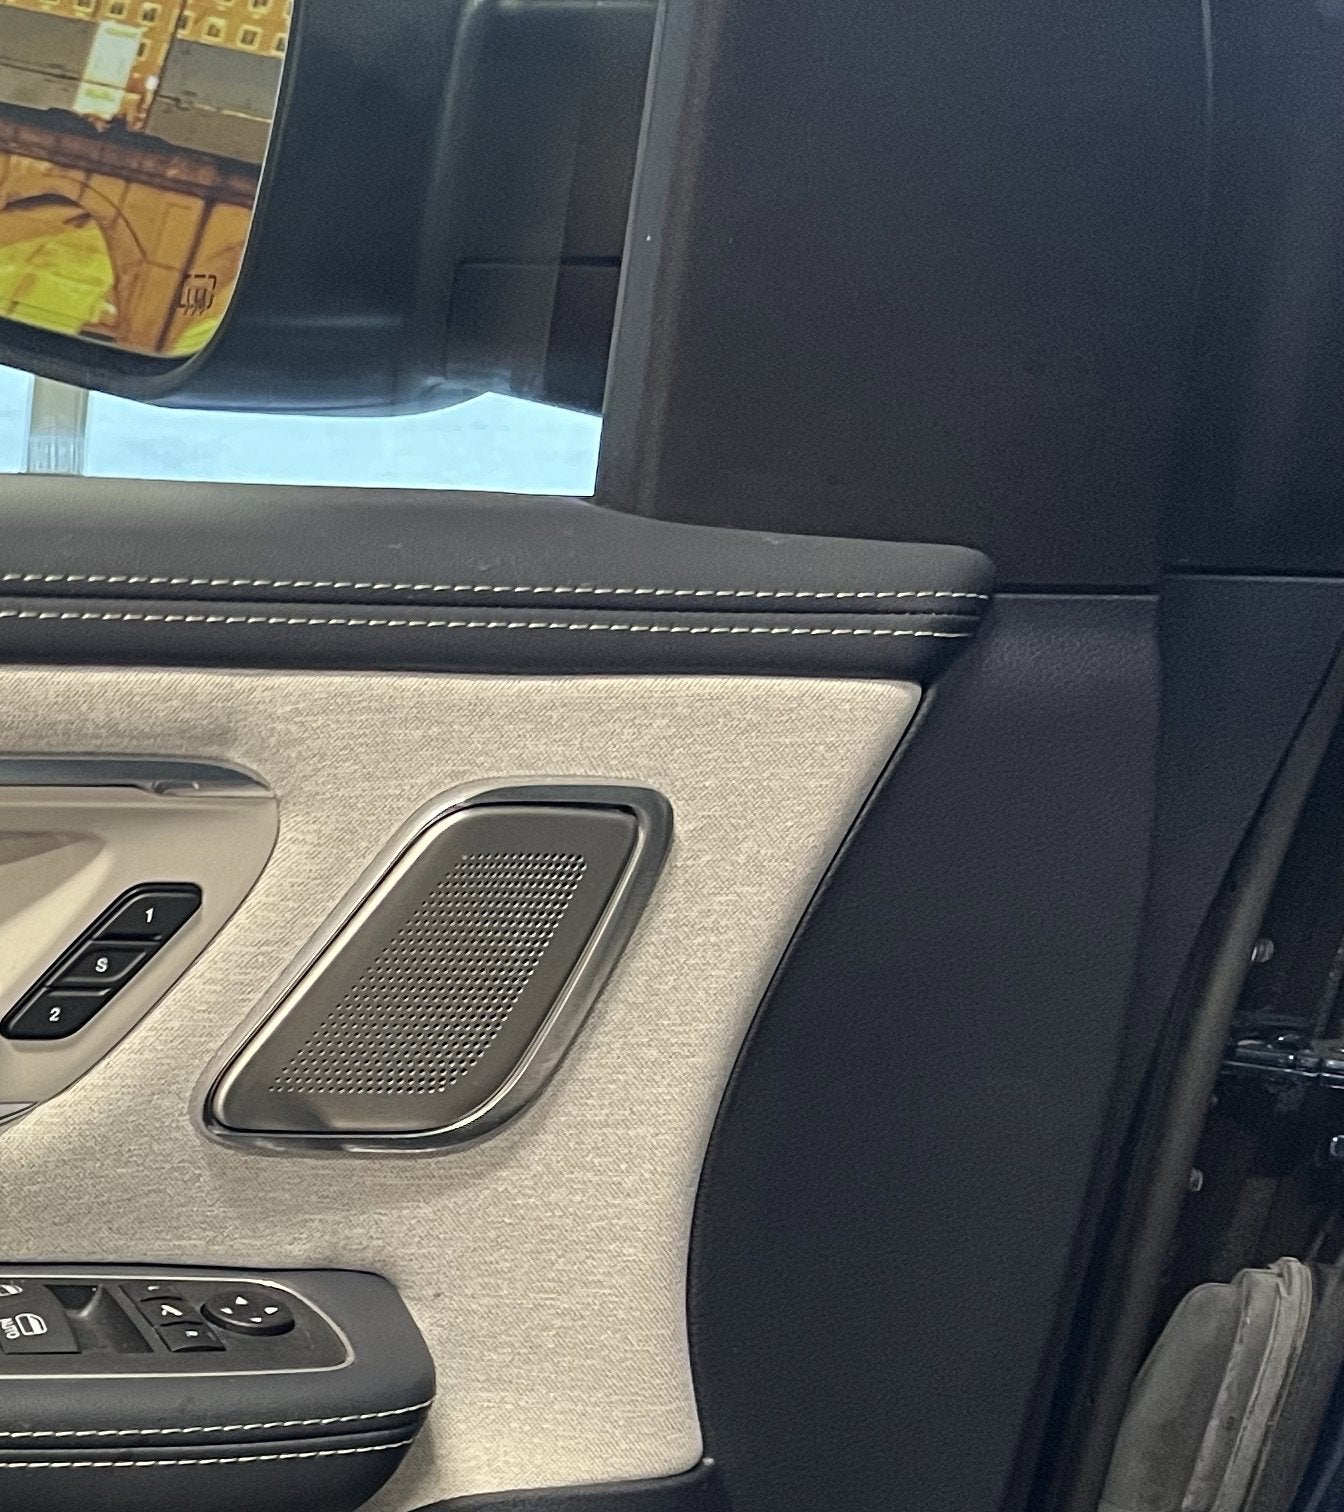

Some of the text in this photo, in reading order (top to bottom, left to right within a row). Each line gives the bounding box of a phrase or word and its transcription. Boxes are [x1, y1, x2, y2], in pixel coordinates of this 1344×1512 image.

[144, 907, 154, 923] 1
[95, 957, 109, 973] S
[49, 1007, 61, 1022] 2
